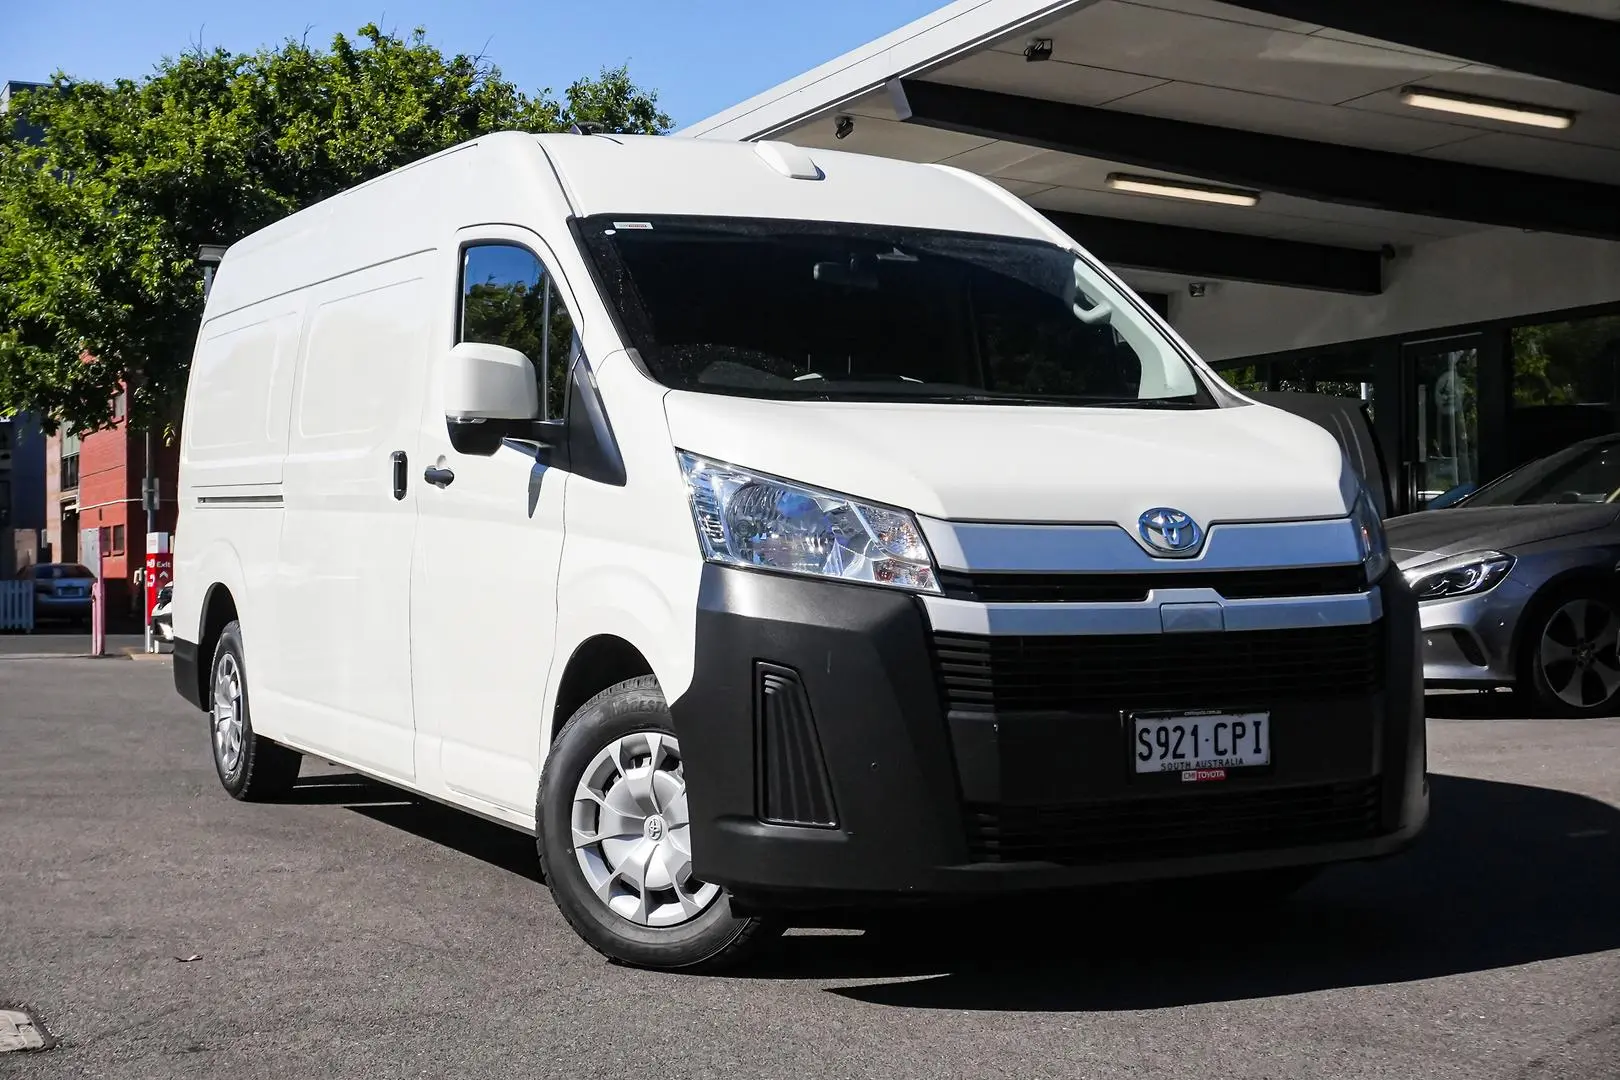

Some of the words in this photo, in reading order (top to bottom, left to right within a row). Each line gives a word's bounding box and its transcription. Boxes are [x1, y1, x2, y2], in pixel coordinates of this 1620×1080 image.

[1160, 760, 1191, 771] SOUTH
[1195, 757, 1244, 769] AUSTRALIA
[1197, 770, 1225, 779] TOYOTA
